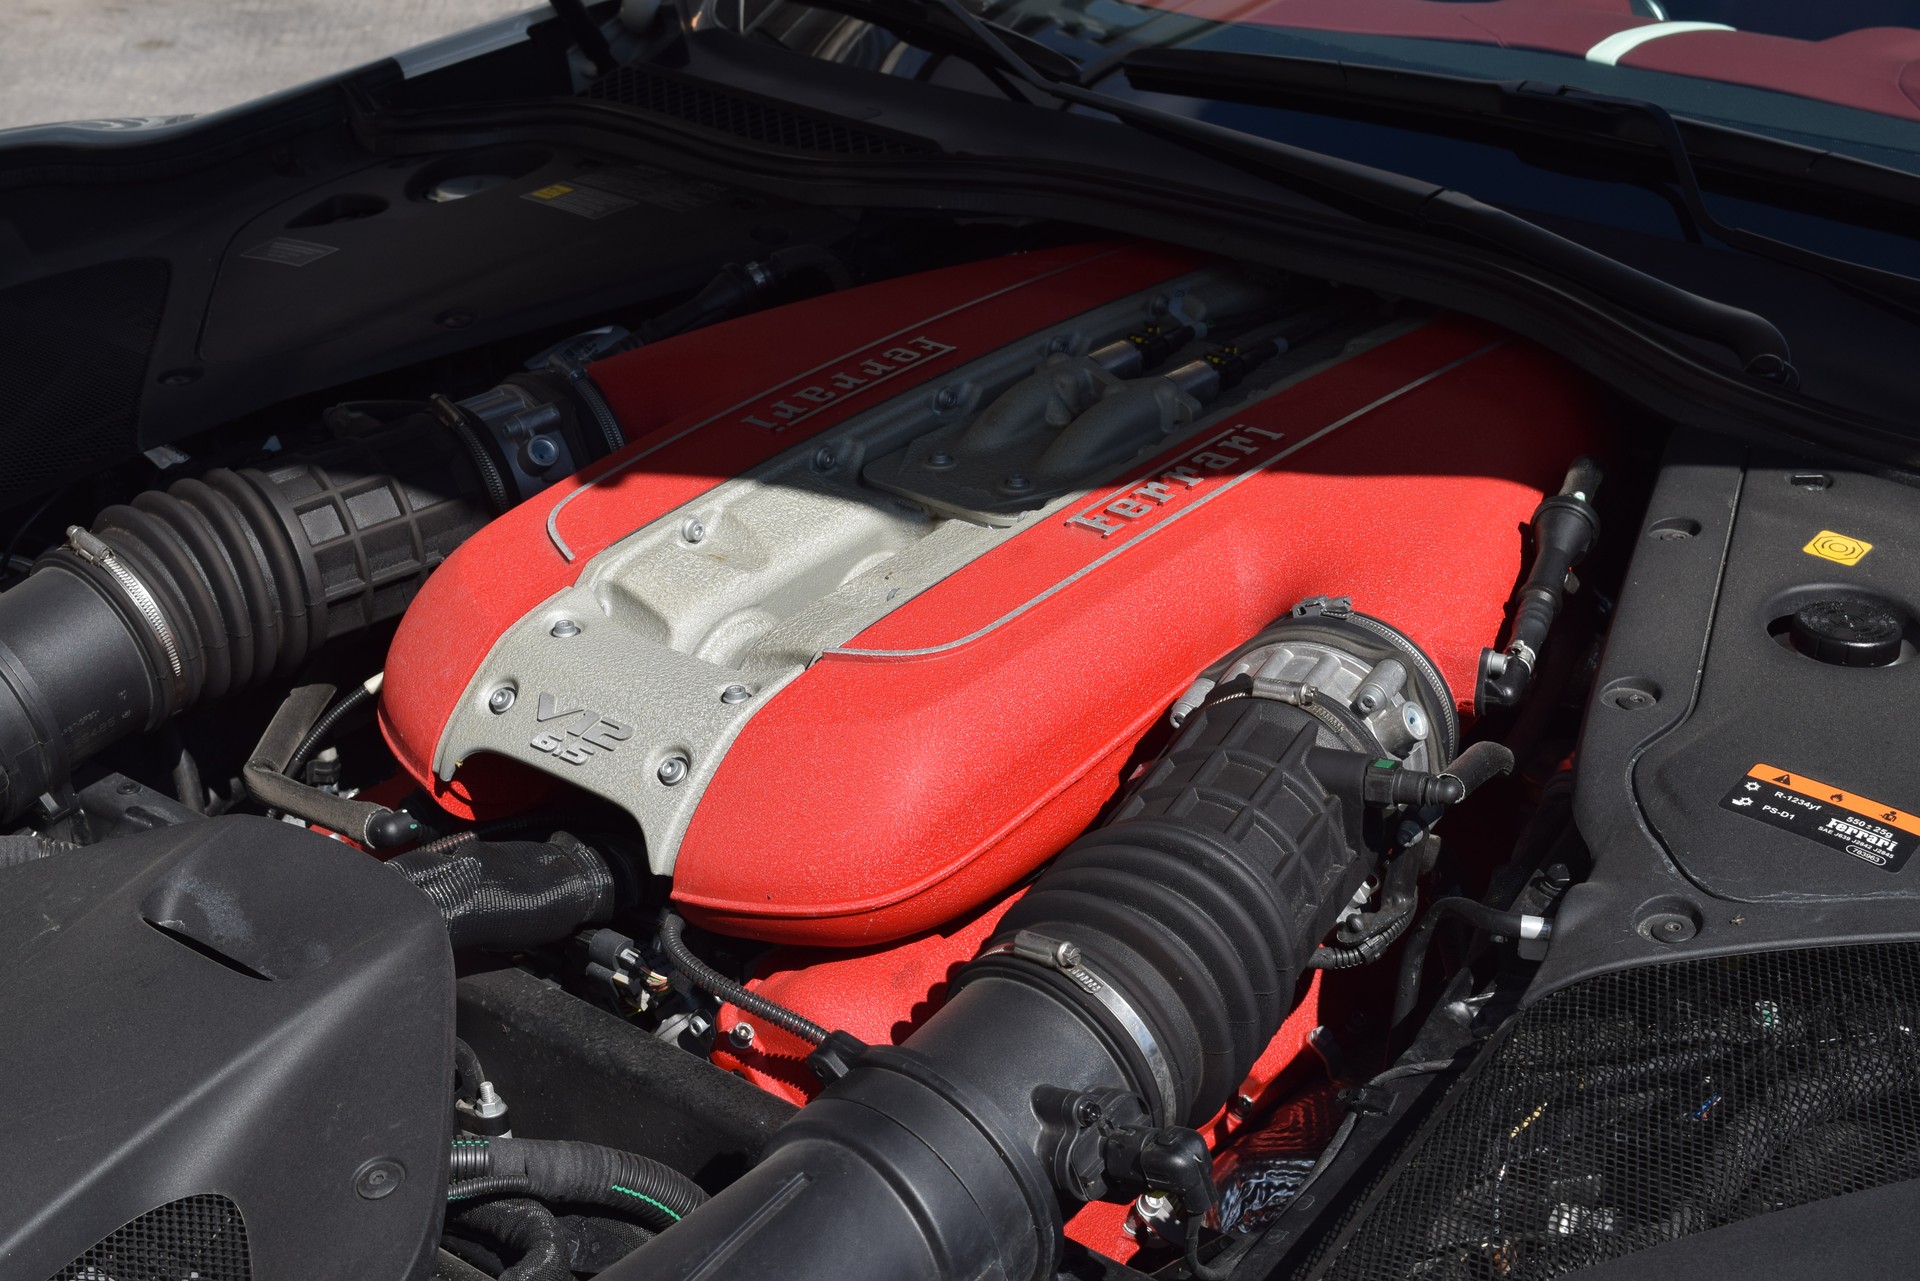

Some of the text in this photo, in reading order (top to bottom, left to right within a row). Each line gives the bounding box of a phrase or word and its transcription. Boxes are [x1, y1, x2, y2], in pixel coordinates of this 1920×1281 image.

[741, 336, 957, 432] Ferrari
[1064, 424, 1285, 538] Ferrari
[537, 691, 635, 751] V12
[530, 730, 594, 766] 6.5
[1762, 804, 1795, 820] PS-D1
[1774, 791, 1822, 811] R-1234yf
[1818, 826, 1833, 834] SAE
[1834, 832, 1851, 841] J639
[1826, 818, 1898, 852] Ferrari
[1846, 816, 1866, 827] 550
[1873, 826, 1893, 838] 25g
